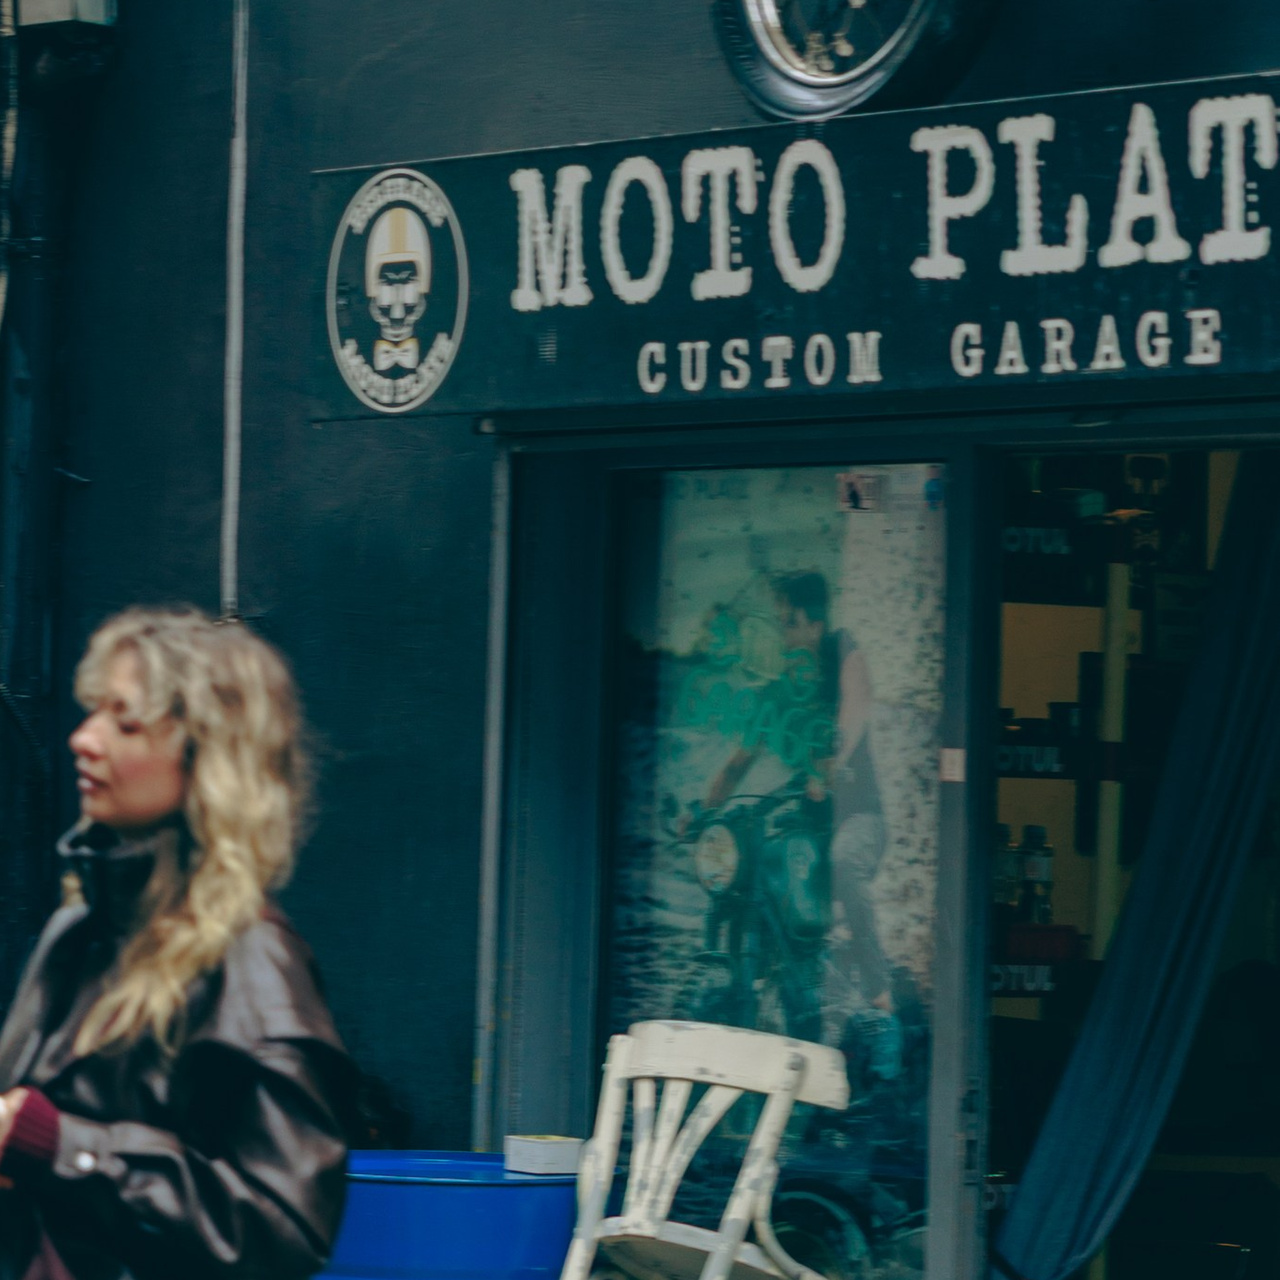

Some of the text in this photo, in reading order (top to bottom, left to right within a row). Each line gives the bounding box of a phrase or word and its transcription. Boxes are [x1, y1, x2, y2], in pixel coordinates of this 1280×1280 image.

[510, 139, 845, 311] MOTO
[637, 309, 1222, 393] CUSTOM GARAGE
